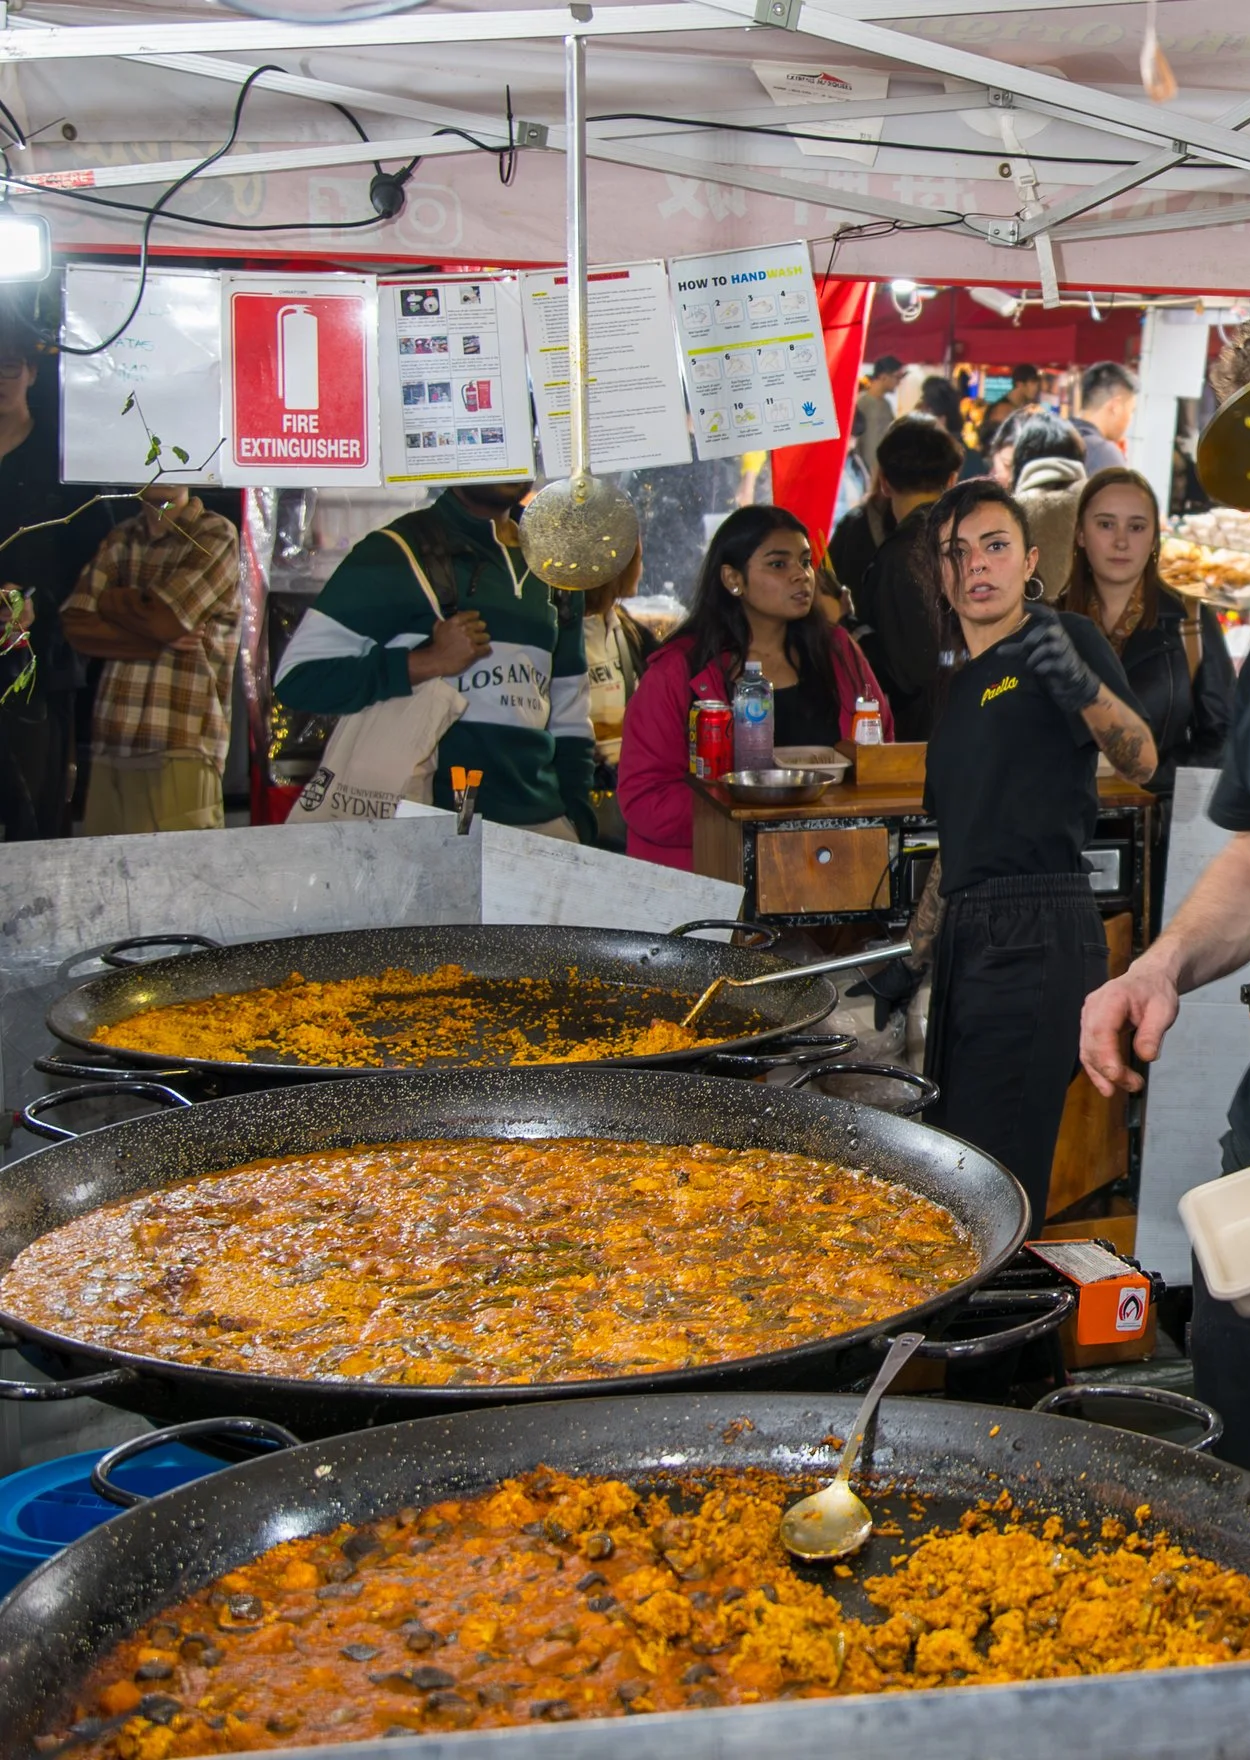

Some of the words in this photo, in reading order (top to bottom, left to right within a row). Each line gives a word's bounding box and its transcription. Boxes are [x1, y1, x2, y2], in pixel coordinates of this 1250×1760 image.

[678, 277, 708, 292] HOW
[712, 276, 727, 287] TO
[731, 266, 803, 284] HANDWASH
[691, 358, 697, 366] 5
[699, 408, 705, 416] 9
[282, 414, 319, 433] FIRE
[240, 438, 361, 458] EXTINGUISHER
[458, 665, 503, 693] LOS
[501, 694, 523, 707] NEW
[980, 676, 1019, 707] Paella
[350, 785, 394, 800] UNIVERSITY
